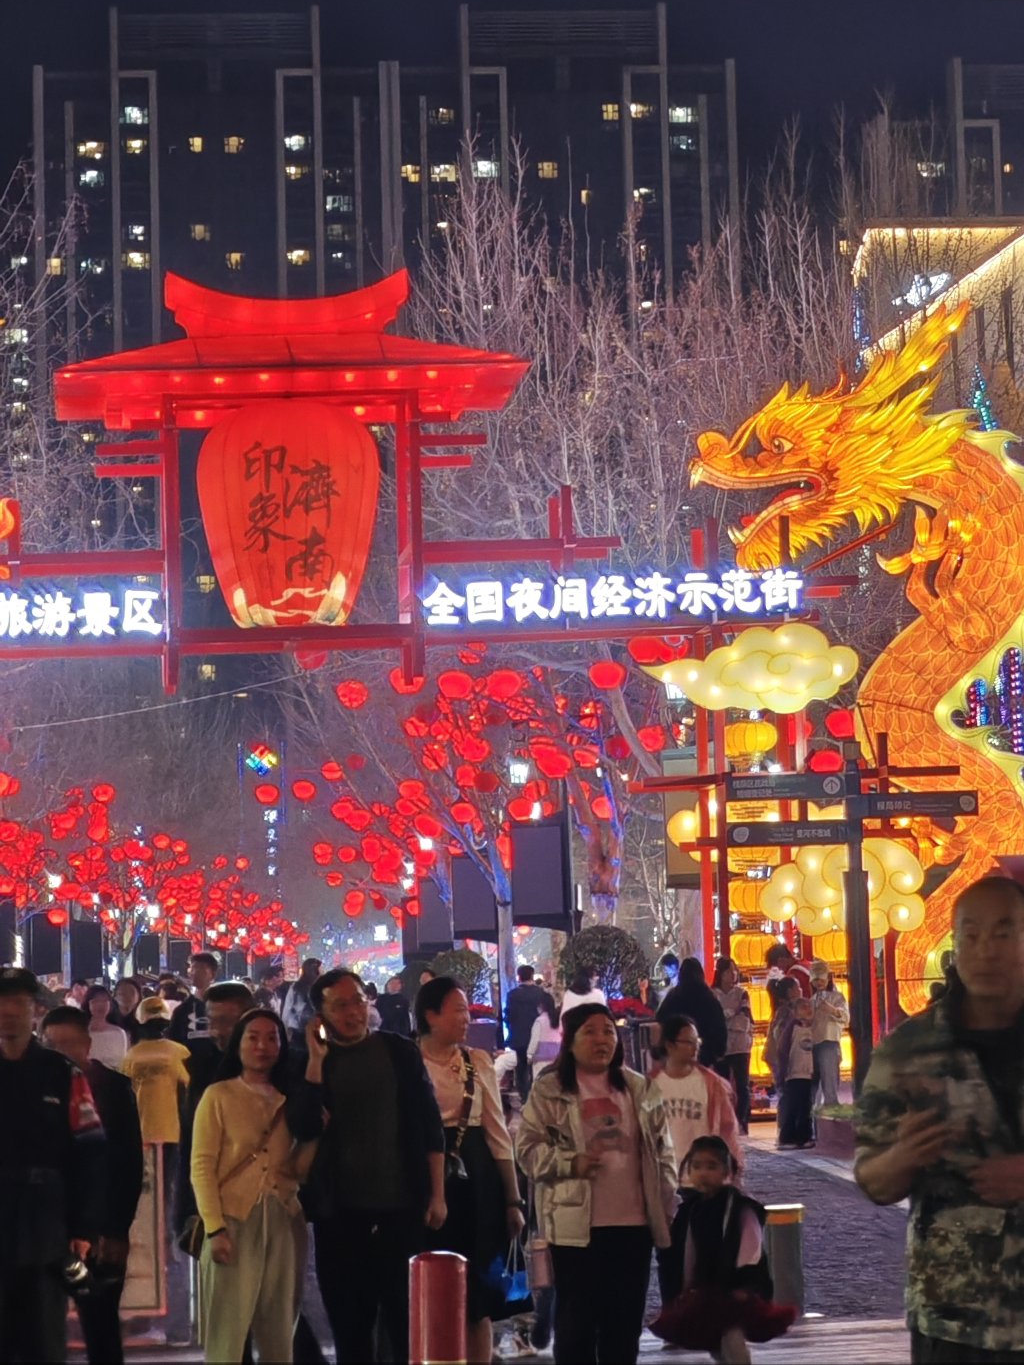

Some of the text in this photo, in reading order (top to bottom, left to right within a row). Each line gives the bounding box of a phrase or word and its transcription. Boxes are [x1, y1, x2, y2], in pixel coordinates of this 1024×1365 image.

[0, 590, 163, 638] 旅游景区
[423, 569, 804, 625] 全国夜间经济示范街
